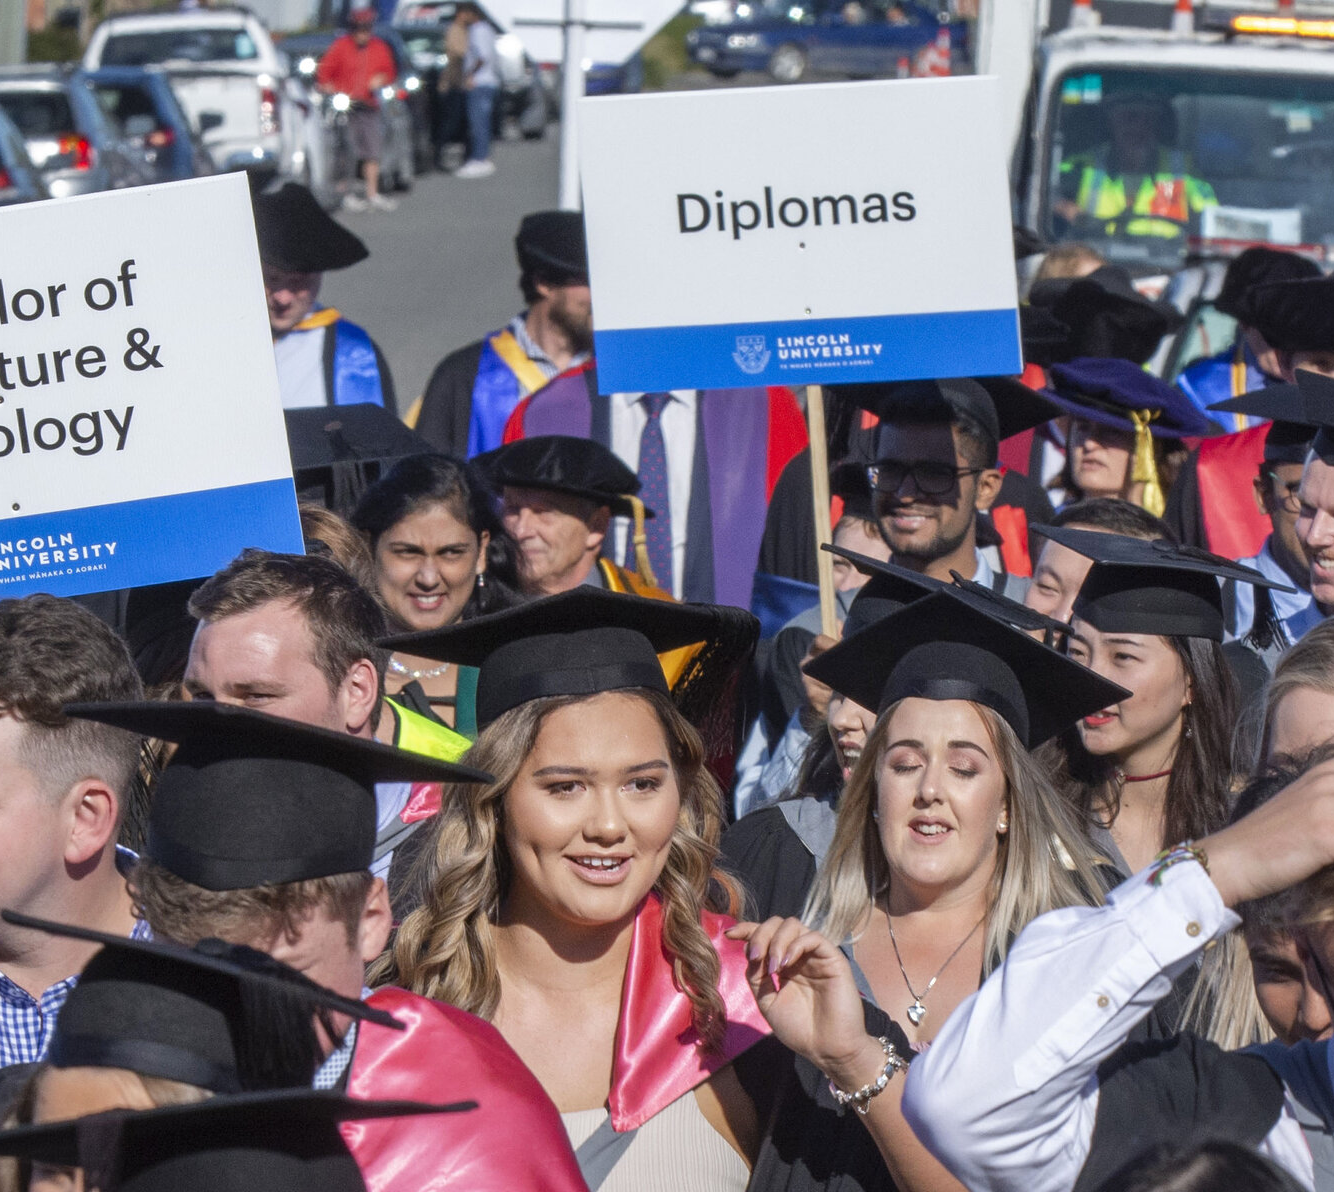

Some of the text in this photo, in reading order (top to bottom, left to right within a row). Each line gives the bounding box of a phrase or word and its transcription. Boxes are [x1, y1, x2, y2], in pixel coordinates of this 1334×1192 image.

[677, 186, 916, 240] Diplomas
[83, 260, 137, 311] of
[123, 327, 164, 371] &
[778, 334, 849, 348] LINCOLN
[778, 343, 883, 360] UNIVERSITY
[75, 563, 107, 573] AORAKI
